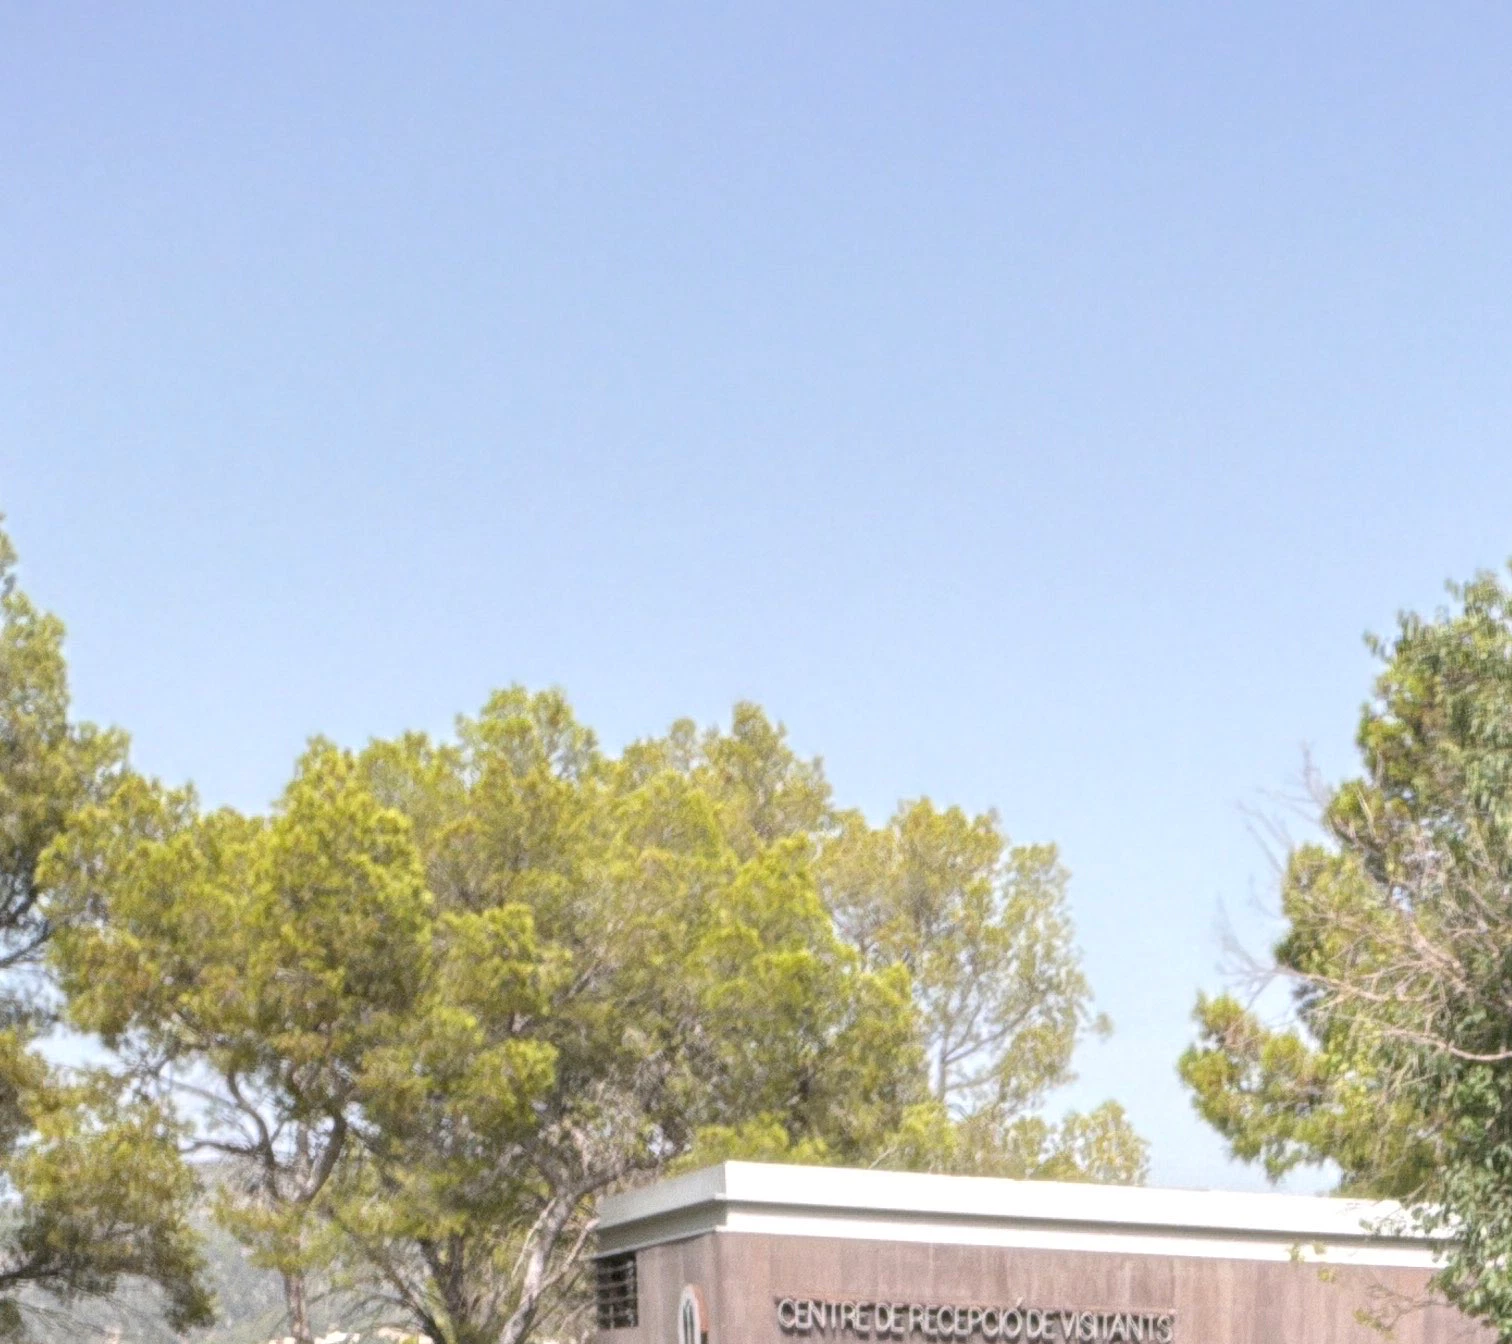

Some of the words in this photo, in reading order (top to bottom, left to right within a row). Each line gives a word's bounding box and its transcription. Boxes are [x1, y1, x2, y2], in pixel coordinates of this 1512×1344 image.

[777, 1298, 871, 1332] CENTRE
[875, 1302, 905, 1333] DE
[908, 1296, 1023, 1338] RECEPCIÓ
[1026, 1308, 1056, 1340] DE
[1060, 1309, 1174, 1344] VISITANTS
